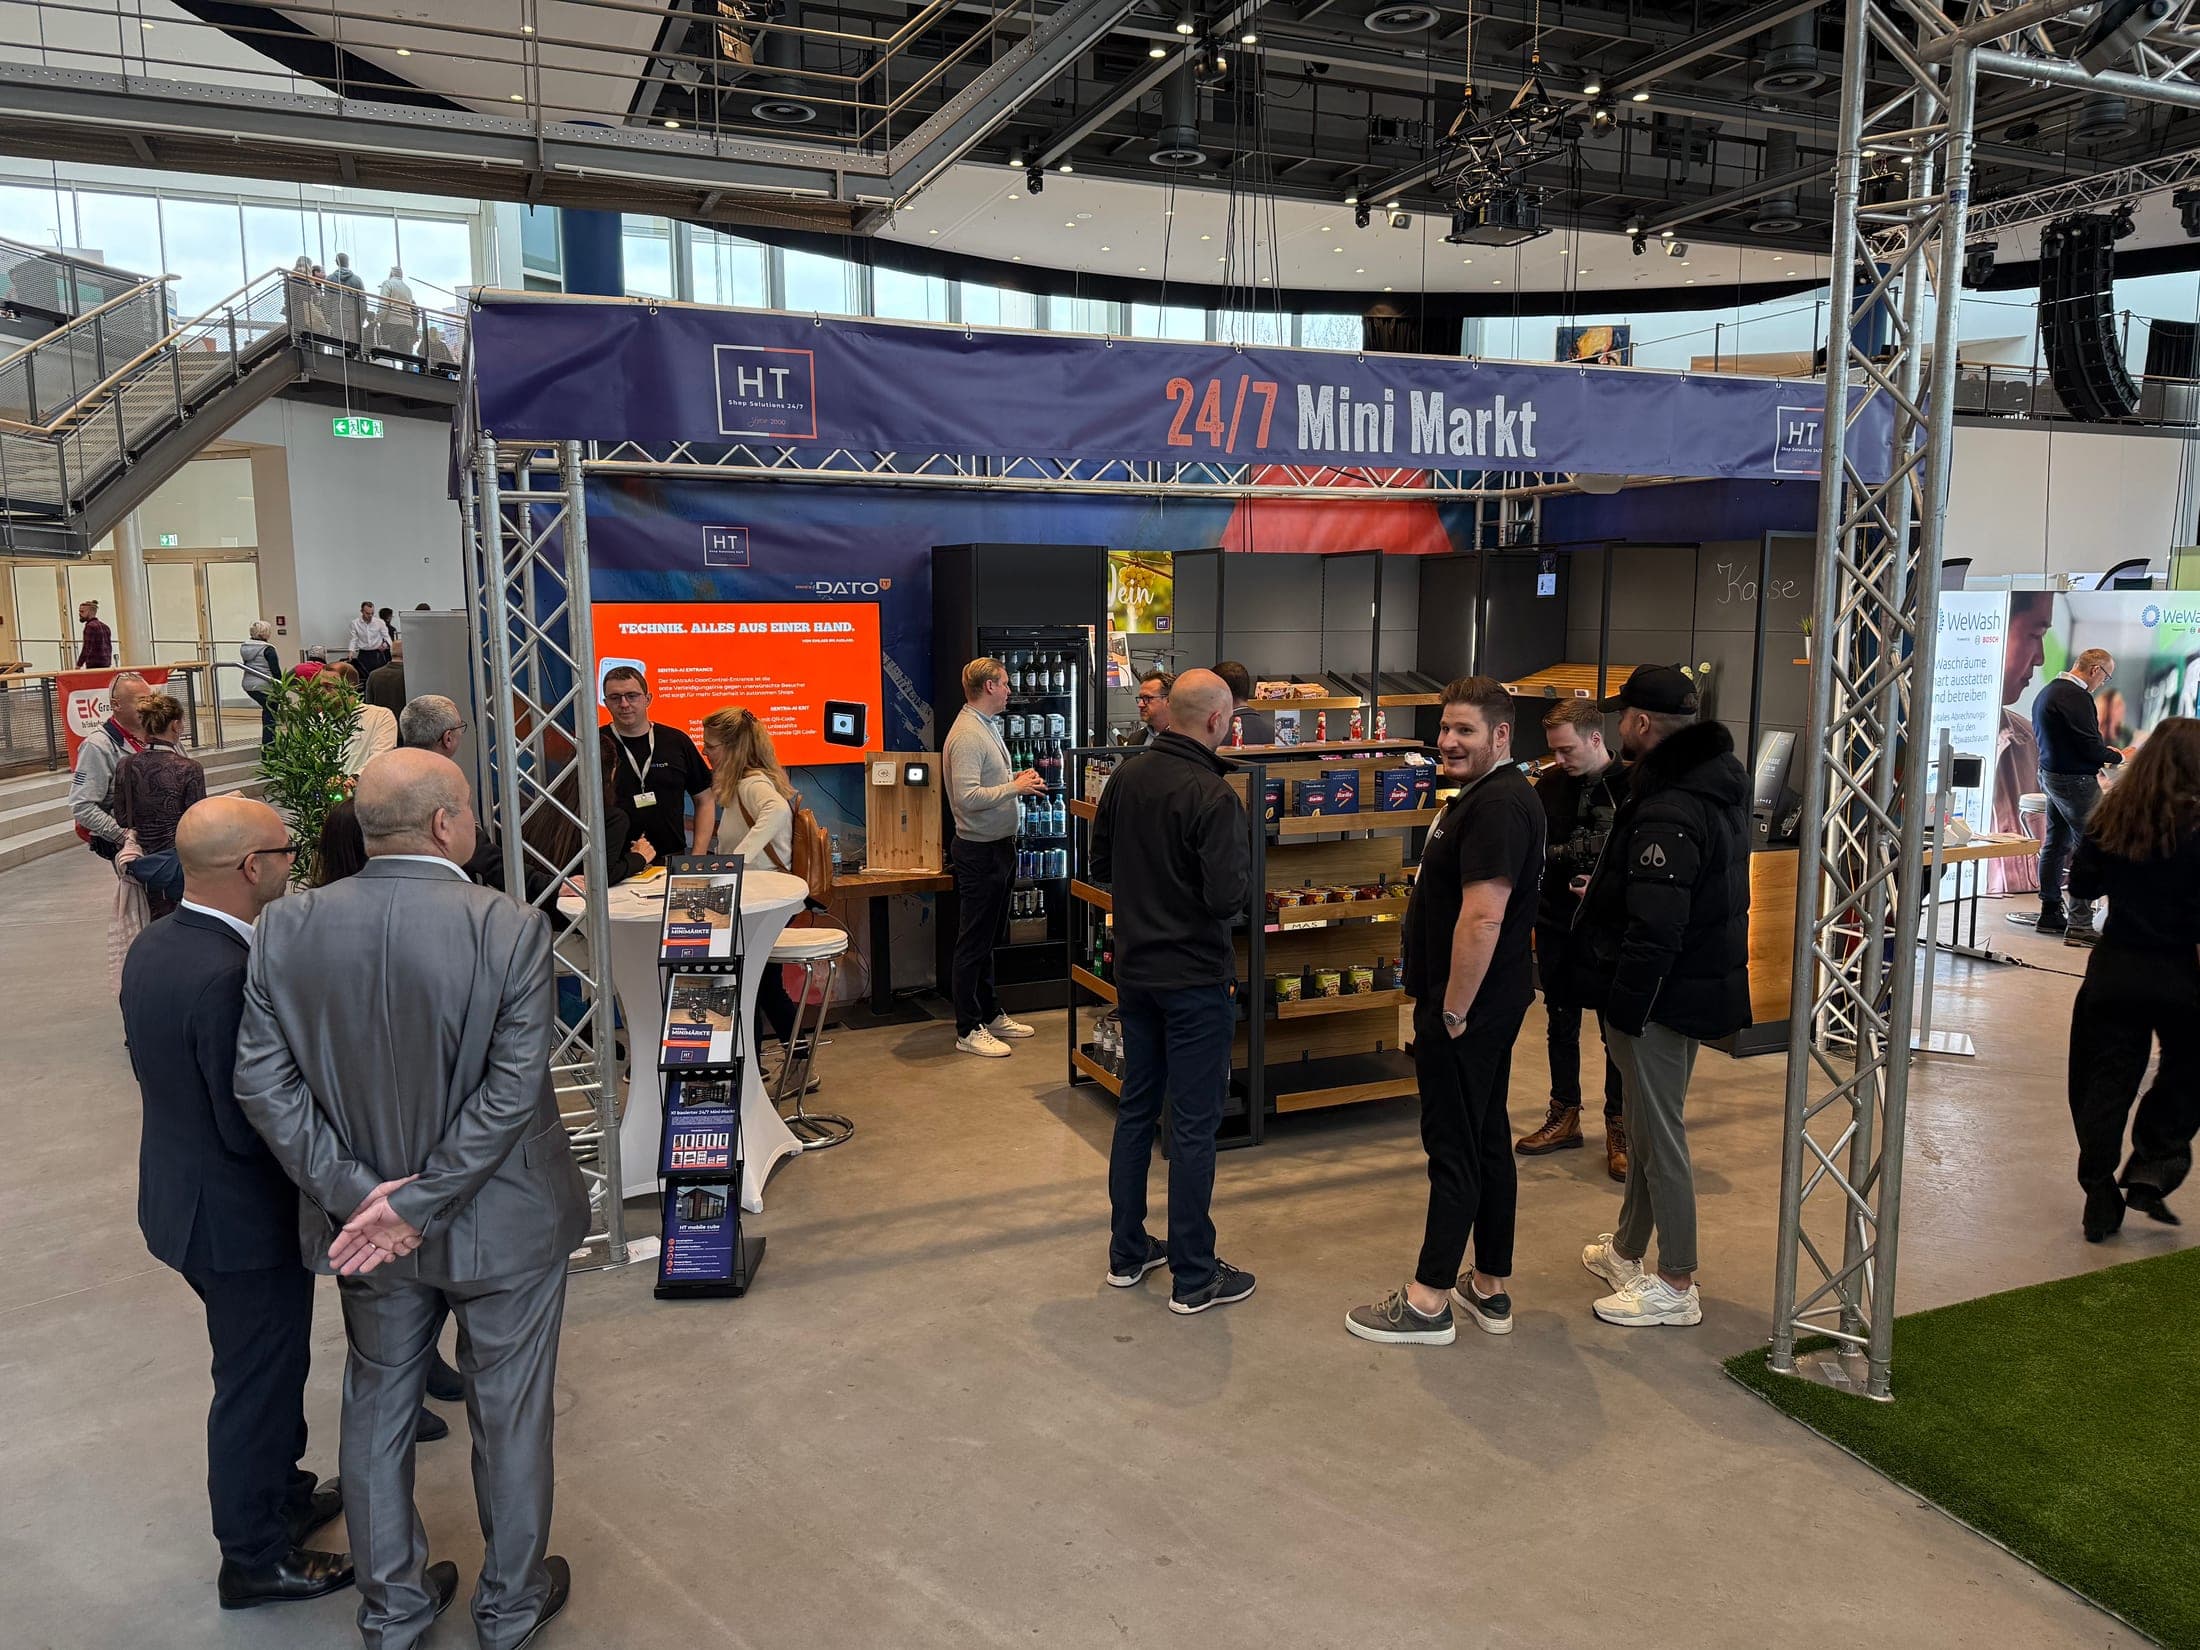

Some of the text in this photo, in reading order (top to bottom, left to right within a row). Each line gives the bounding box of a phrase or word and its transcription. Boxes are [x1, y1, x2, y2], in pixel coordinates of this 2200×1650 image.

[738, 366, 790, 399] HT
[749, 401, 785, 409] Solutions
[1166, 374, 1537, 458] 24/7 Mini Markt
[1788, 421, 1818, 446] HT
[713, 535, 738, 550] HT
[815, 581, 879, 594] DATO
[619, 621, 855, 634] TECHNIK. ALLES AUS EINER HAND.
[1948, 609, 2000, 631] WeWash
[1951, 673, 1993, 686] ausstatten
[1948, 689, 1987, 702] betreiben
[76, 697, 100, 718] EK
